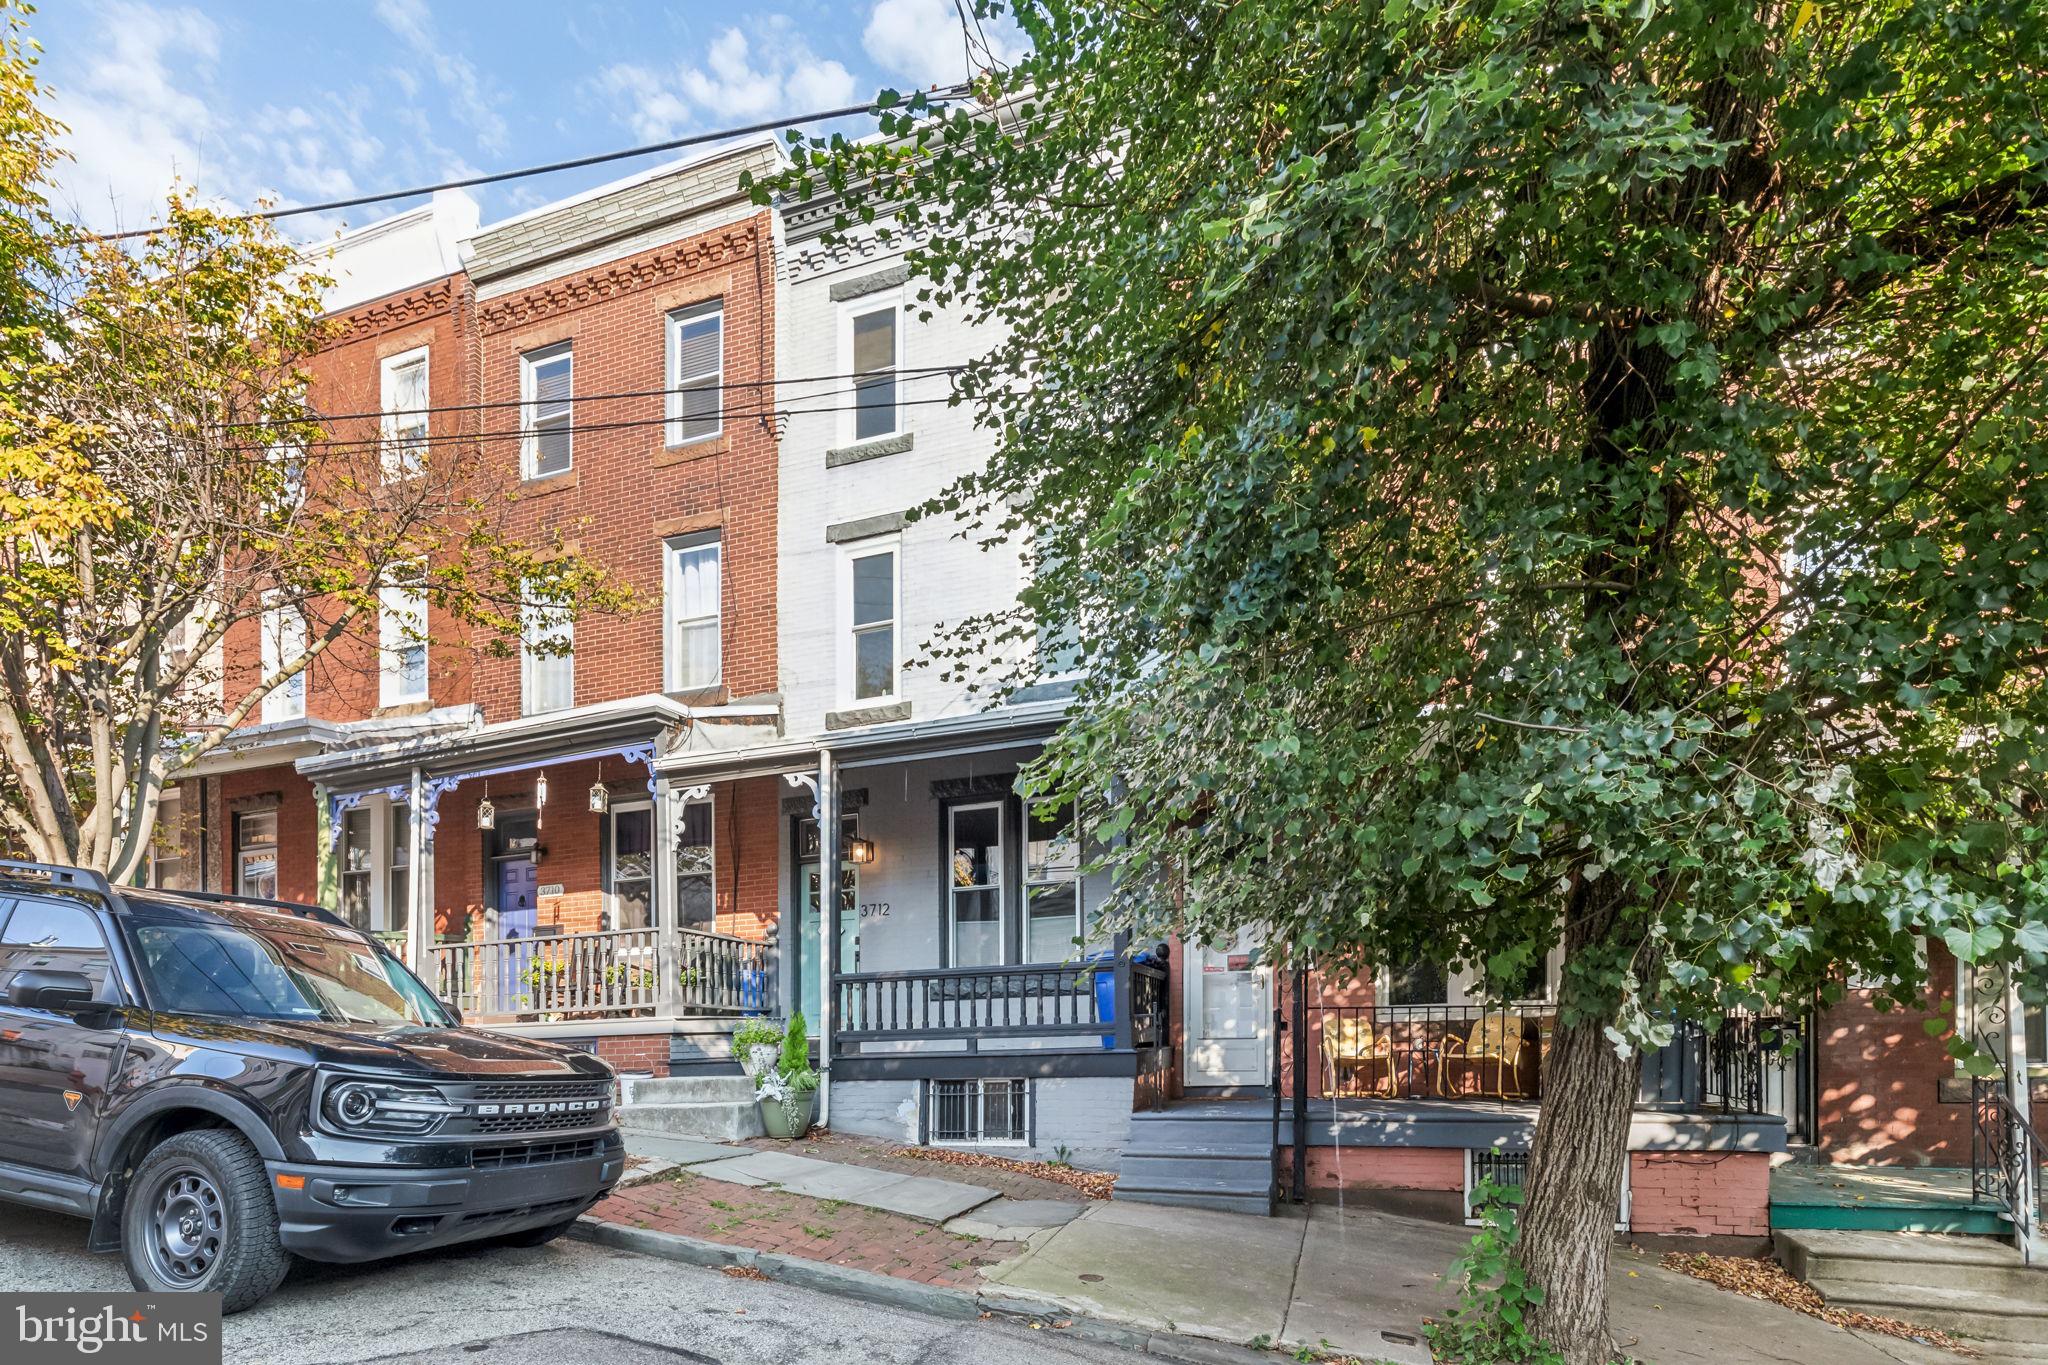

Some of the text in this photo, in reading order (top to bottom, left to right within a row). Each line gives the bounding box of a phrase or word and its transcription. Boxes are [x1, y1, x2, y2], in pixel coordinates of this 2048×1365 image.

[540, 885, 560, 896] 3710
[860, 903, 890, 917] 3712
[477, 1100, 600, 1115] BRONCO
